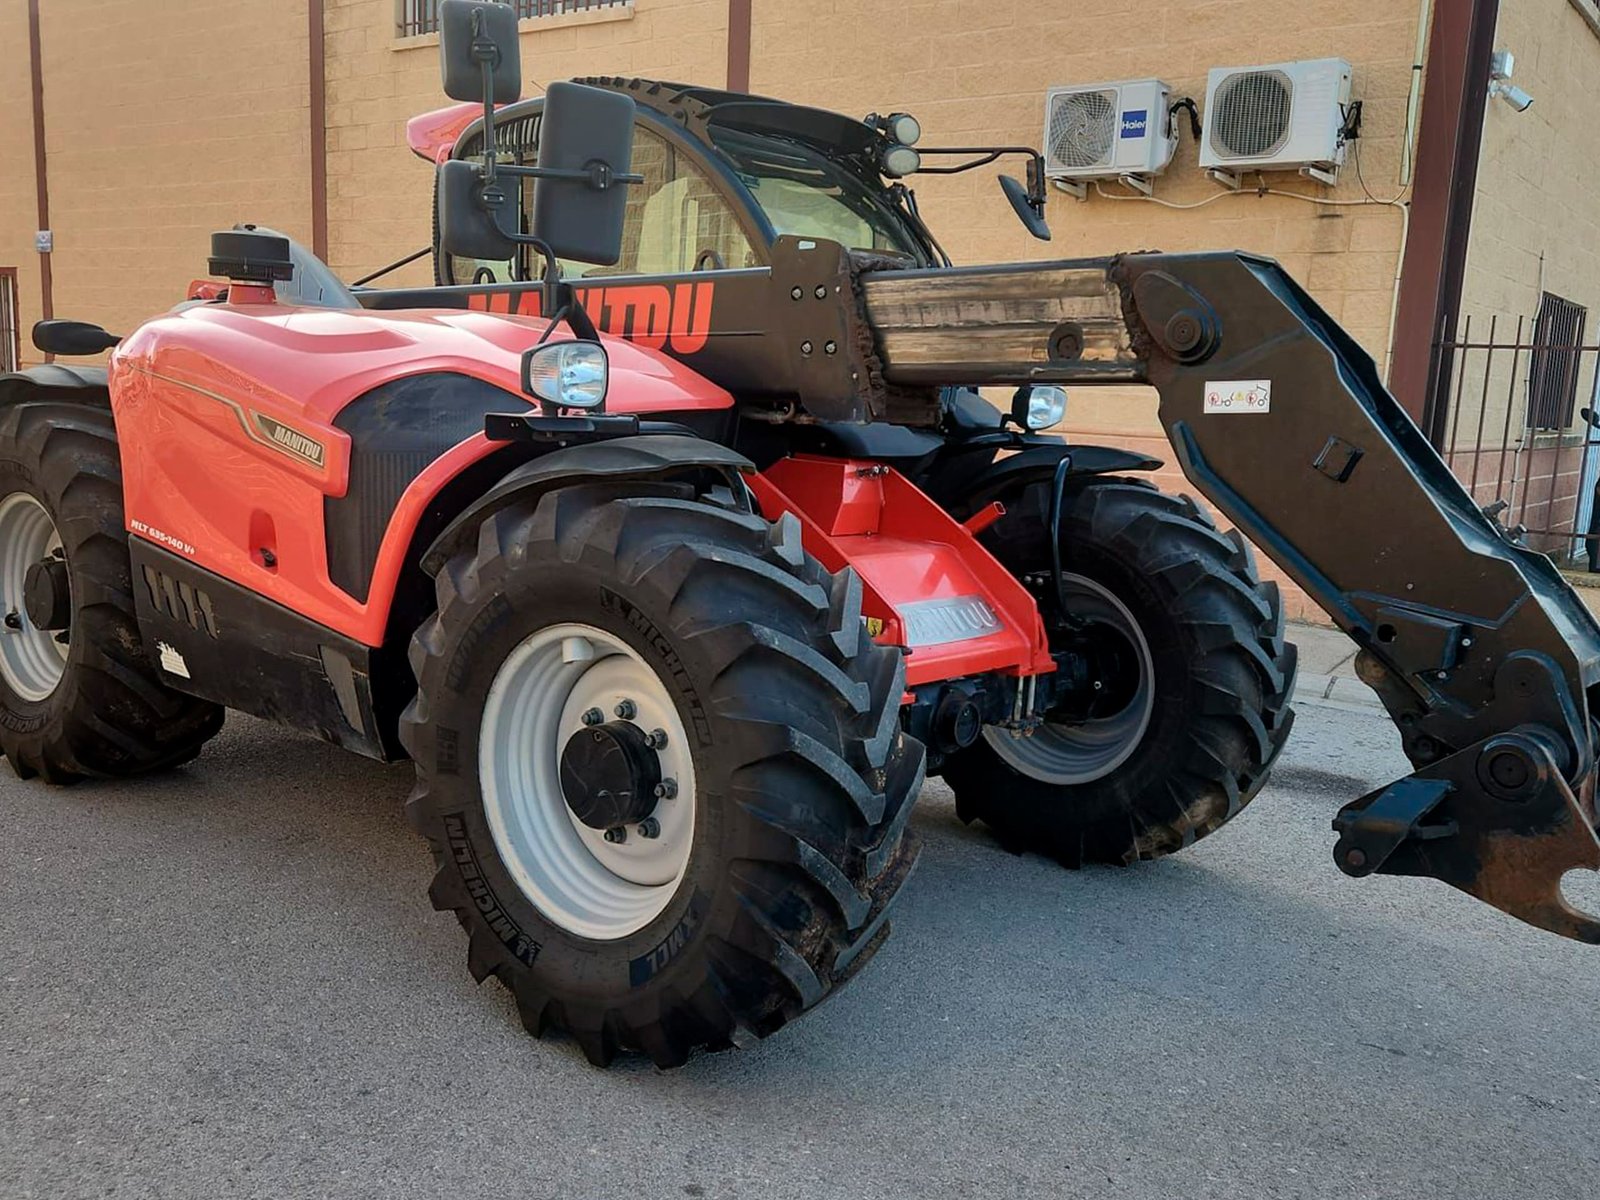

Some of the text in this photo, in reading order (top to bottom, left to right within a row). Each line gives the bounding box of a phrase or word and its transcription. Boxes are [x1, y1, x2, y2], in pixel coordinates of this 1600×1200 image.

[1122, 120, 1146, 130] Haier
[467, 282, 714, 354] ITOU
[274, 426, 321, 459] MANITOU
[130, 519, 196, 555] MLT 635-140 V+
[627, 607, 712, 745] MICHELIN
[445, 817, 518, 943] MICHELIN
[645, 906, 698, 975] XMCL
